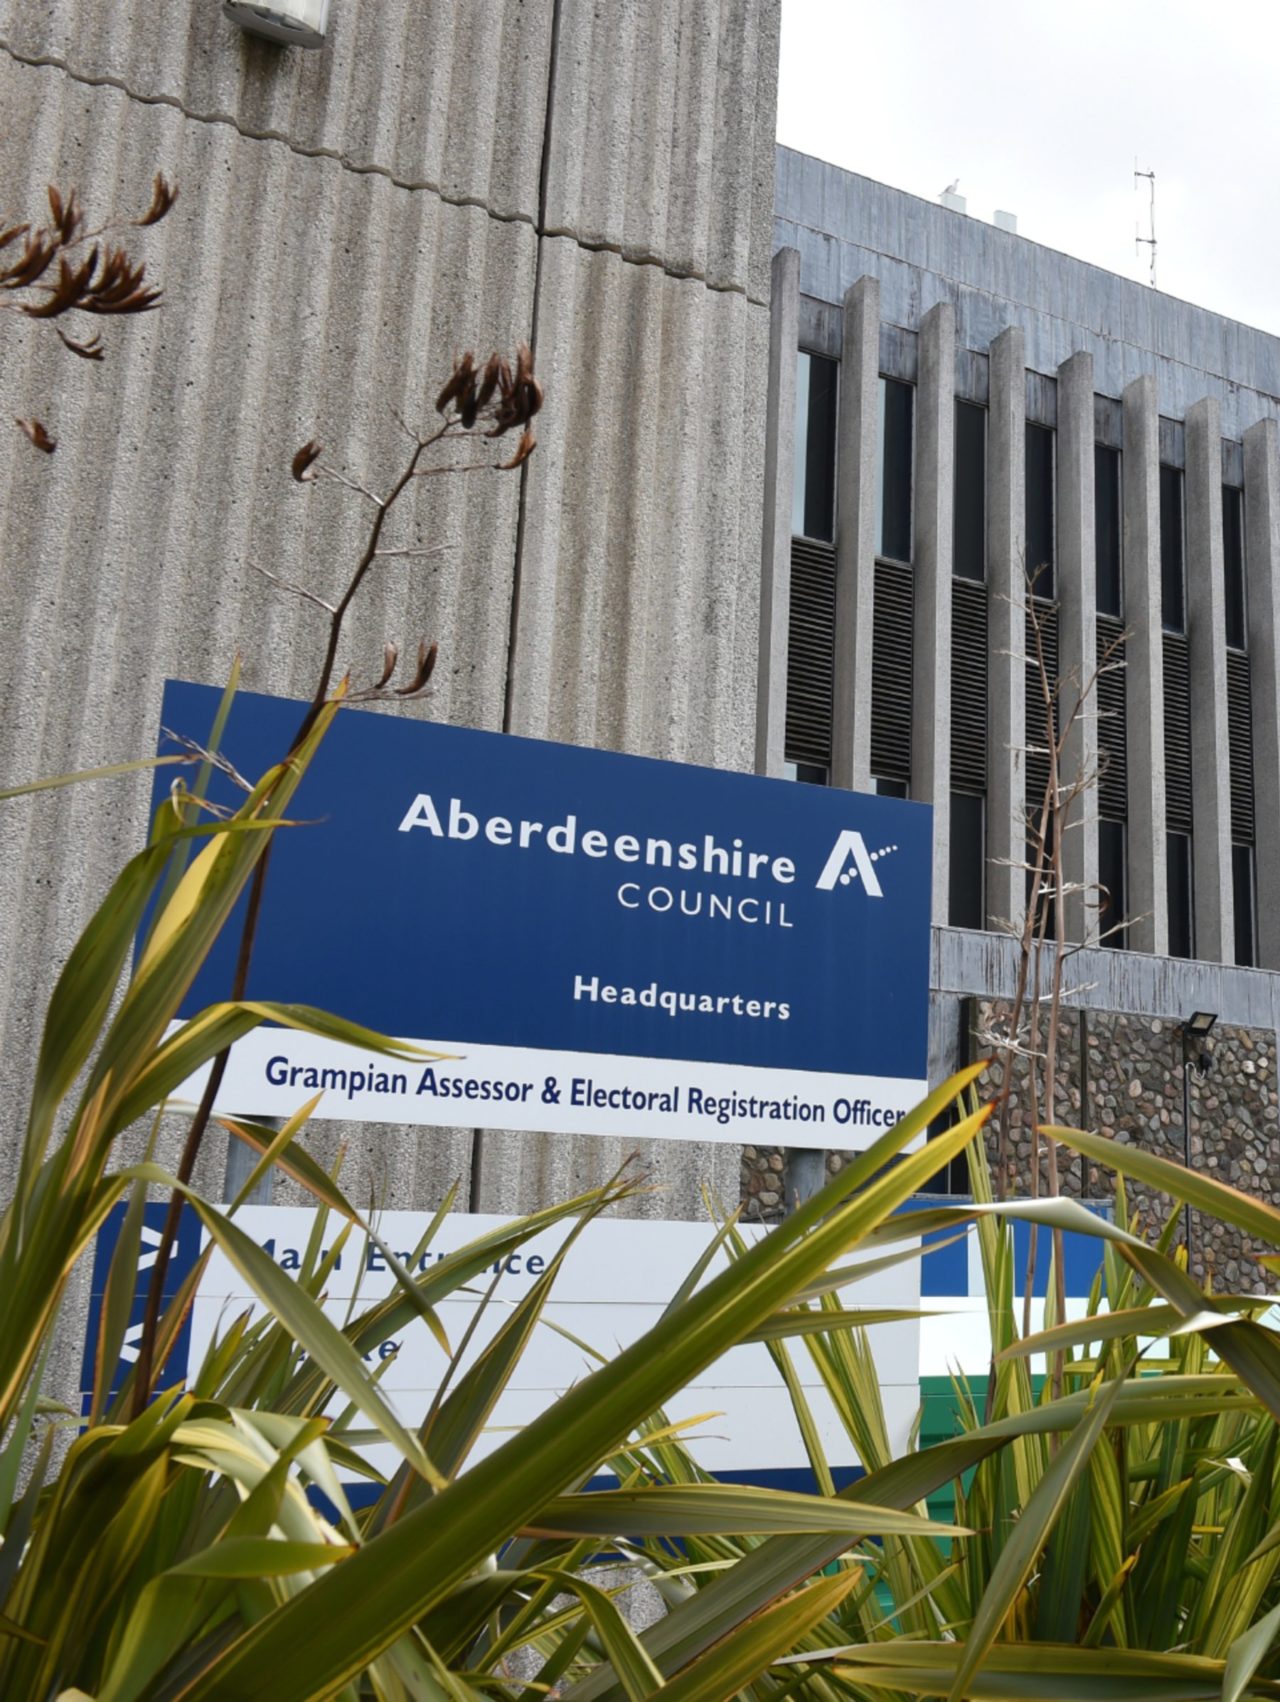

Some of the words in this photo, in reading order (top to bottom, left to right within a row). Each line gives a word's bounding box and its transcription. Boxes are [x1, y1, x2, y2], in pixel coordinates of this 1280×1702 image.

[399, 793, 796, 884] Aberdeenshire
[617, 882, 795, 928] COUNCIL
[573, 975, 790, 1022] Headquarters
[264, 1056, 408, 1100] Grampian
[415, 1067, 534, 1103] Assessor
[541, 1076, 562, 1105] &
[570, 1077, 680, 1114] Electoral
[687, 1087, 825, 1127] Registration
[833, 1098, 906, 1127] Officer
